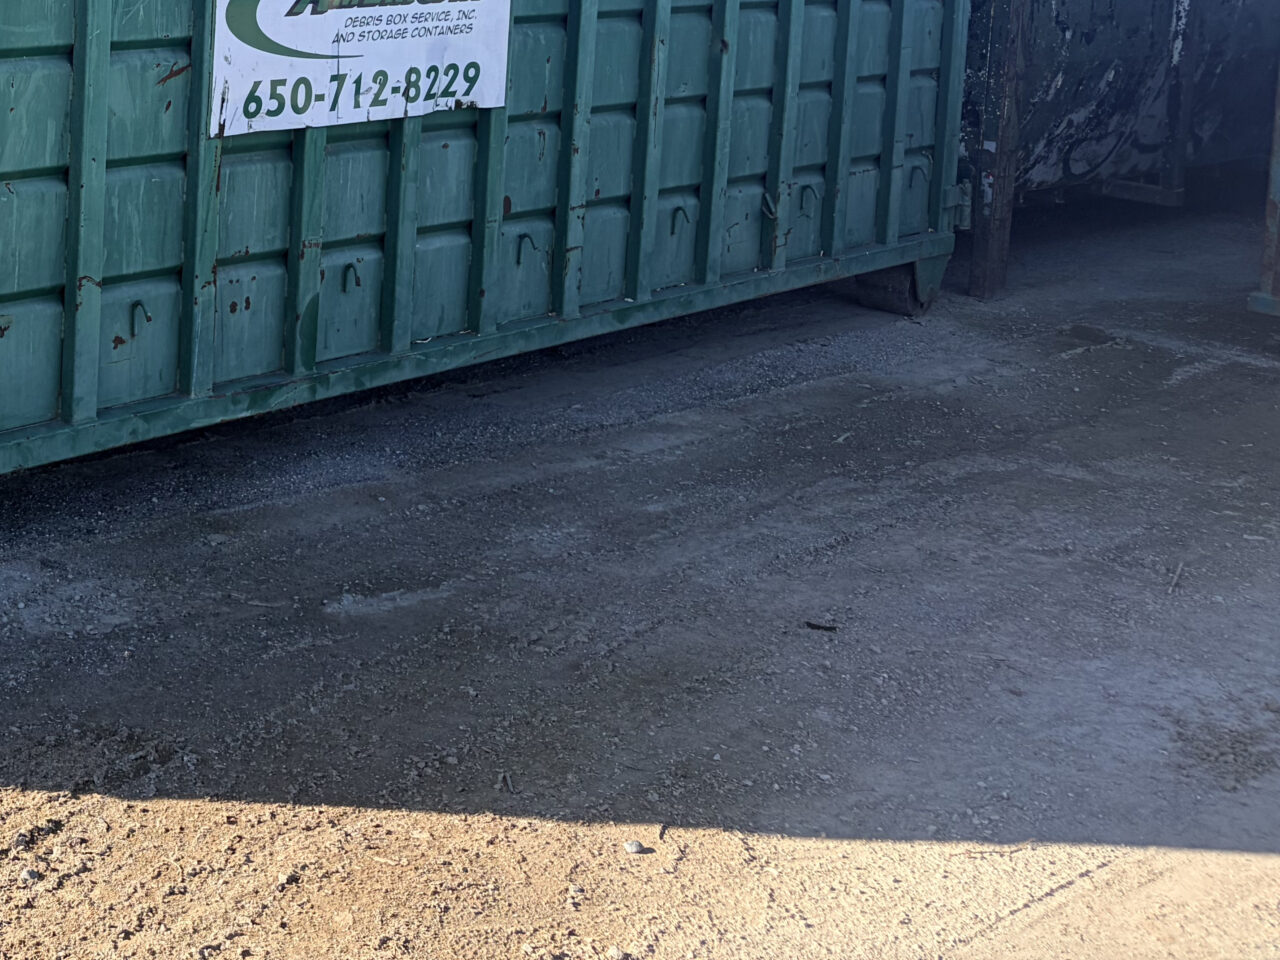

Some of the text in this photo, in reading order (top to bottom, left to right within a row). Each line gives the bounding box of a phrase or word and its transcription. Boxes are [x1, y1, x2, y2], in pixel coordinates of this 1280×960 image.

[344, 9, 477, 28] DEBRIS BOX SERVICE, INC.
[332, 23, 473, 44] AND STORAGE CONTAINERS
[242, 61, 481, 119] 650-712-8229
